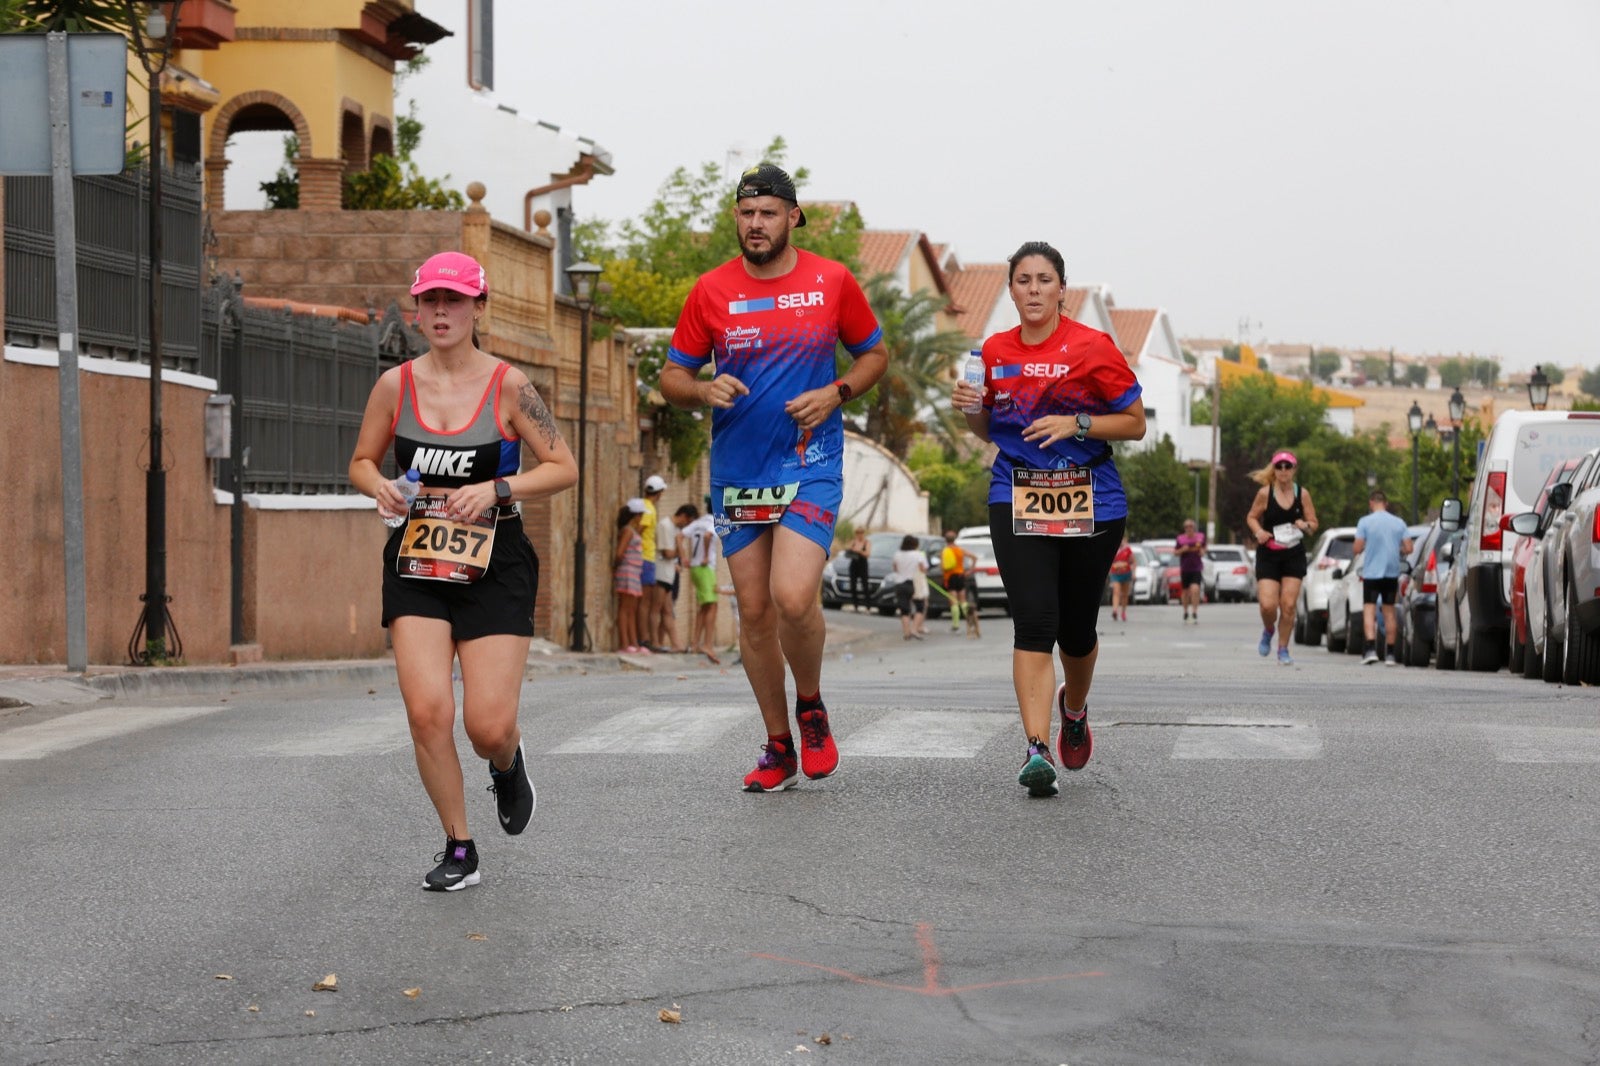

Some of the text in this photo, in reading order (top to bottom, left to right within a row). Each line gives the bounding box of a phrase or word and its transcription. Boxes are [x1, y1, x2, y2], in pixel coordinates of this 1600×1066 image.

[777, 291, 824, 309] SEUR
[1023, 363, 1070, 378] SEUR
[410, 447, 477, 477] NIKE
[1024, 490, 1088, 514] 2002
[412, 524, 488, 559] 2057
